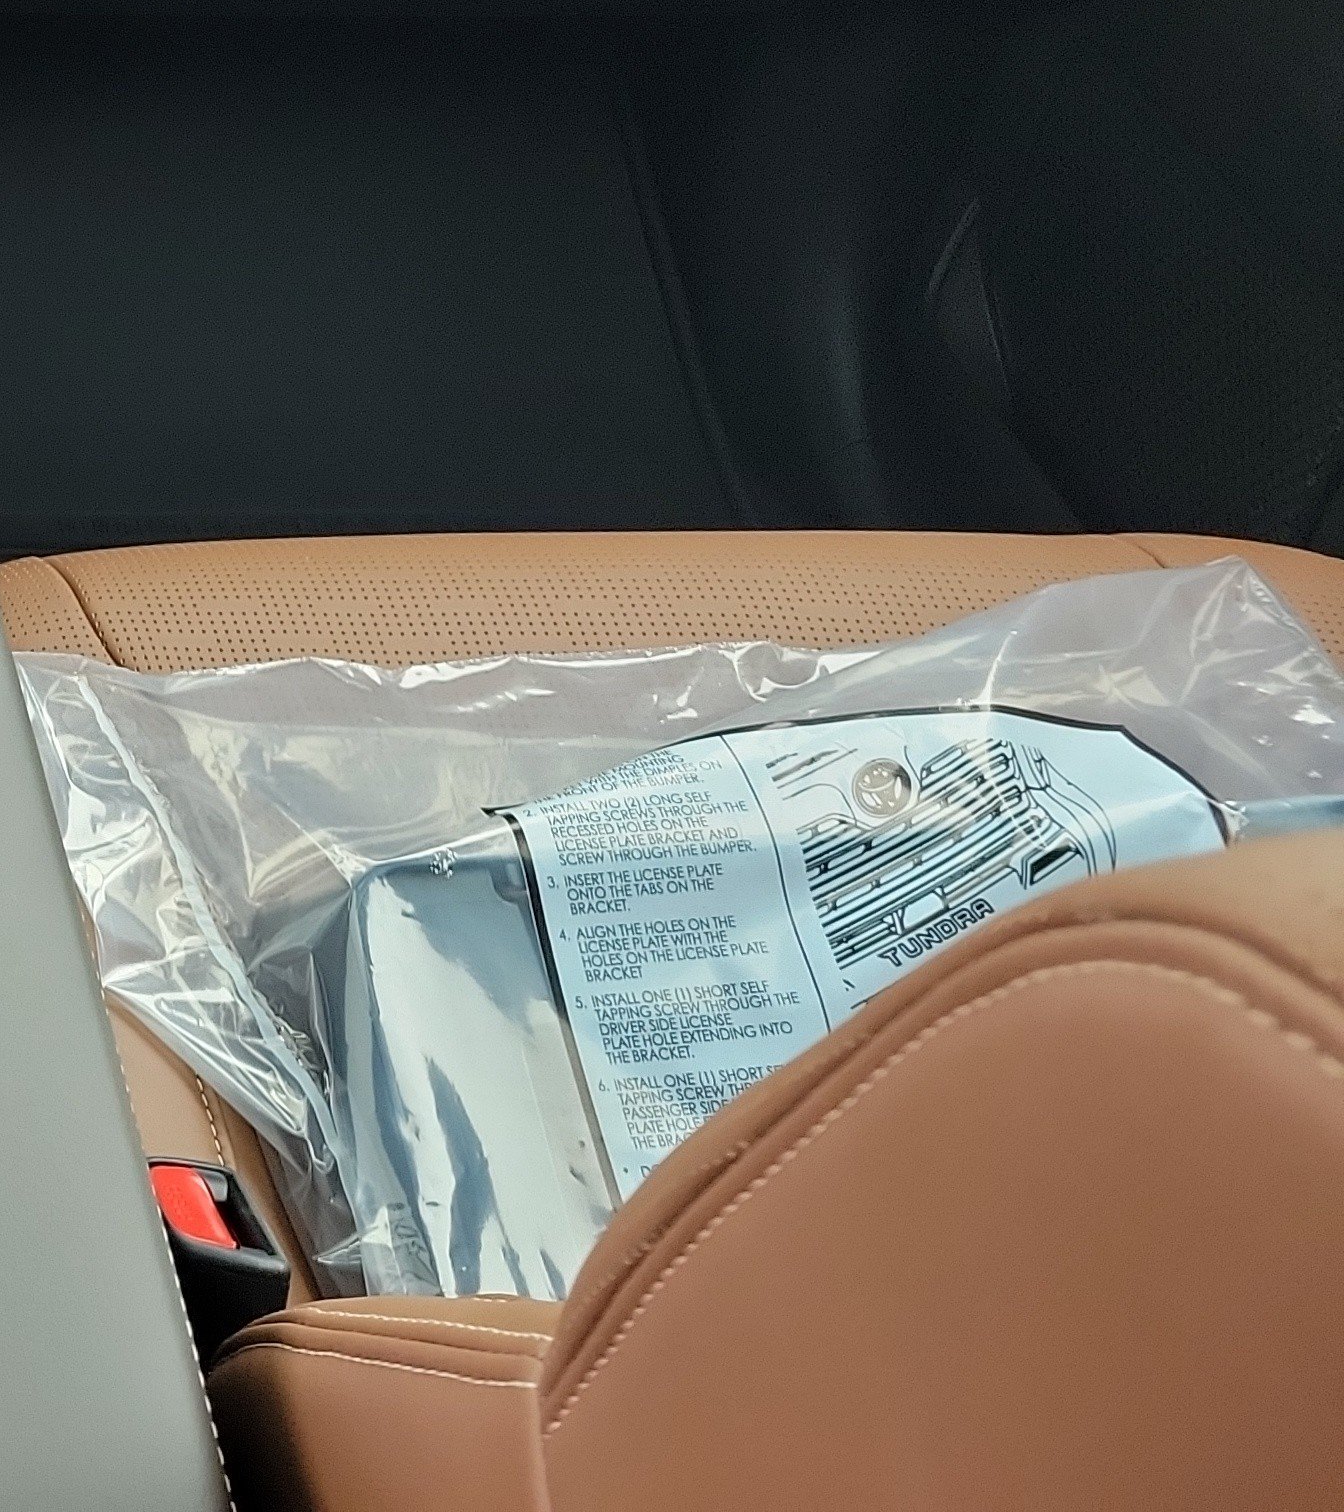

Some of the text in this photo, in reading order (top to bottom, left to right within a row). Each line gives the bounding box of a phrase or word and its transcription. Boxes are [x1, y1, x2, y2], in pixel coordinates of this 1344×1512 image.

[643, 763, 698, 777] DIMPLES
[698, 760, 723, 770] ON
[622, 777, 643, 789] THE
[645, 773, 704, 788] BUMPER.
[540, 800, 587, 815] INSTALL
[589, 798, 620, 811] TWO
[623, 796, 642, 811] (2)
[644, 793, 683, 807] LONG
[684, 791, 712, 803] SELF
[547, 800, 748, 826] TAPPING SCREWS THROUGH THE
[550, 816, 709, 839] RECESSED HOLES ON THE
[555, 827, 739, 852] LICENSE PLATE BRACKET AND
[558, 840, 757, 866] SCREW THROUGH THE BUMPER.
[547, 863, 724, 889] 3. INSERT THE LICENSE PLATE
[567, 878, 714, 901] ONTO THE TABS ON THE
[570, 899, 631, 915] BRACKET.
[559, 915, 737, 941] 4. ALIGN THE HOLES ON THE
[878, 897, 995, 967] TUNDRA
[578, 930, 729, 954] LICENSE PLATE WITH THE
[581, 941, 769, 968] HOLES ON THE LICENSE PLATE
[585, 966, 643, 982] BRACKET
[575, 980, 770, 1009] 5. INSTALL ONE (1) SHORT SELF
[595, 991, 800, 1021] TAPPING SCREW THROUGH THE
[599, 1013, 733, 1036] DRIVER SIDE LICENSE
[602, 1021, 793, 1051] PLATE HOLE EXTENDING INTO
[605, 1046, 695, 1065] THE BRACKET.
[598, 1066, 765, 1092] 6. INSTALL ONE (1) SHORT
[618, 1089, 674, 1106] TAPPING
[676, 1084, 725, 1101] SCREW
[623, 1100, 698, 1121] PASSENGER
[627, 1120, 666, 1135] PLATE
[631, 1135, 655, 1150] THE
